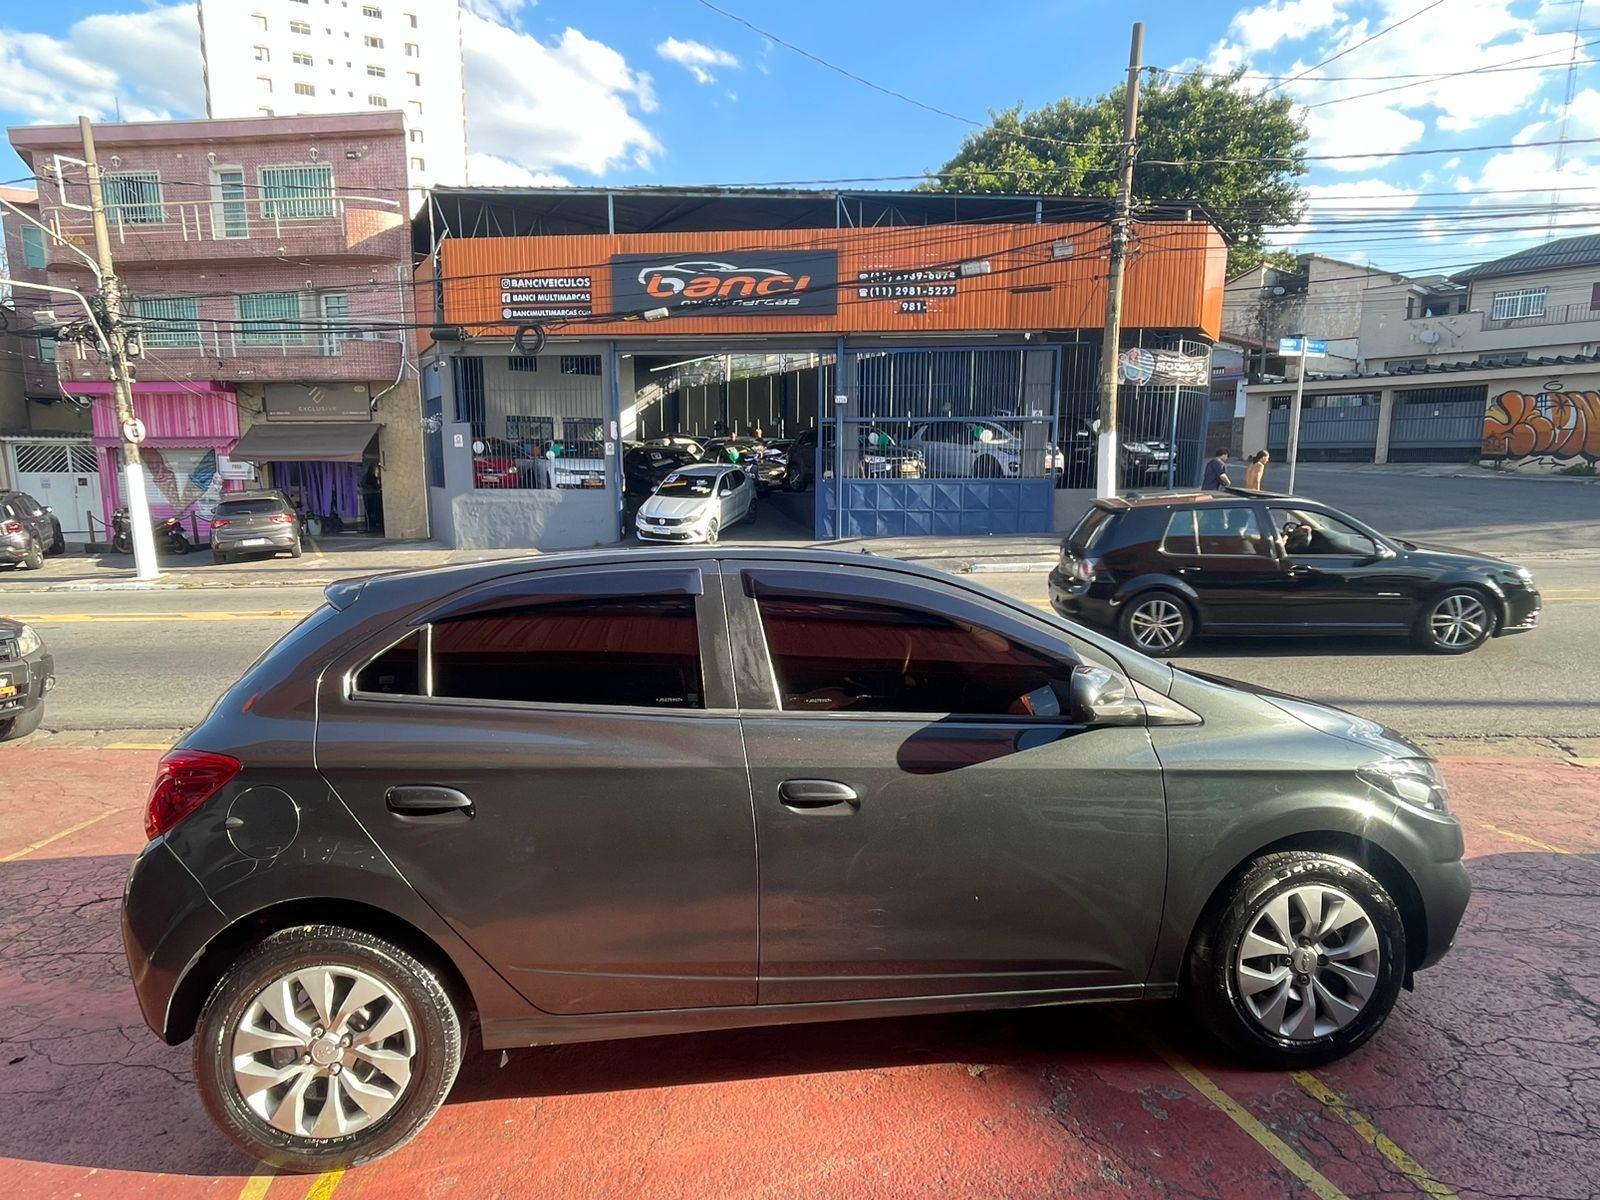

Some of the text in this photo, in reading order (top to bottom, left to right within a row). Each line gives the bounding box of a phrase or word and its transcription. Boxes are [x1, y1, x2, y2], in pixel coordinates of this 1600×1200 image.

[511, 278, 590, 288] BANCIVEICULOS
[646, 273, 811, 298] banci
[870, 286, 955, 297] (11) 2981-5227
[512, 293, 590, 302] BANCI MULTIMARCAS
